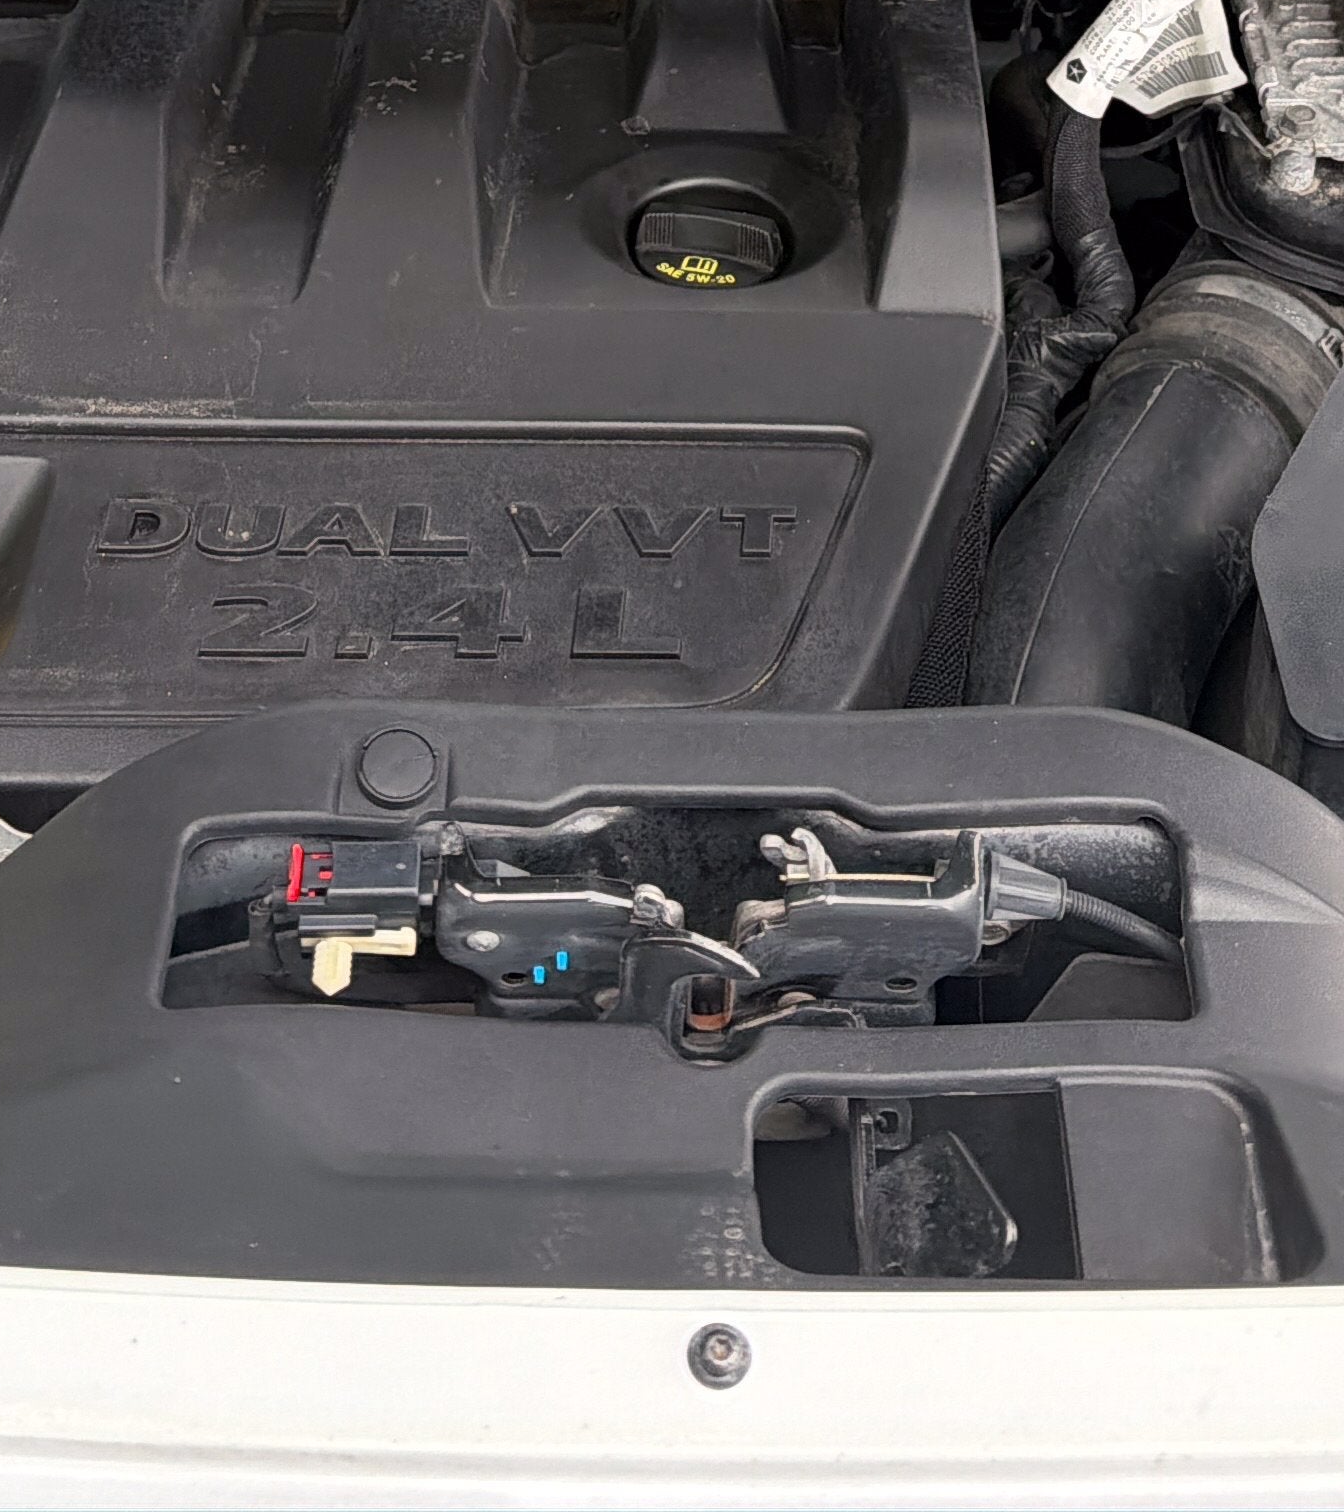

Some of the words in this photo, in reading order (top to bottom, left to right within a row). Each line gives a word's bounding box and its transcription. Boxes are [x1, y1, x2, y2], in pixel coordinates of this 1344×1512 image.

[656, 262, 685, 278] SAE
[686, 273, 736, 284] 5W-20
[96, 498, 471, 559] DUAL
[507, 501, 798, 560] VVT
